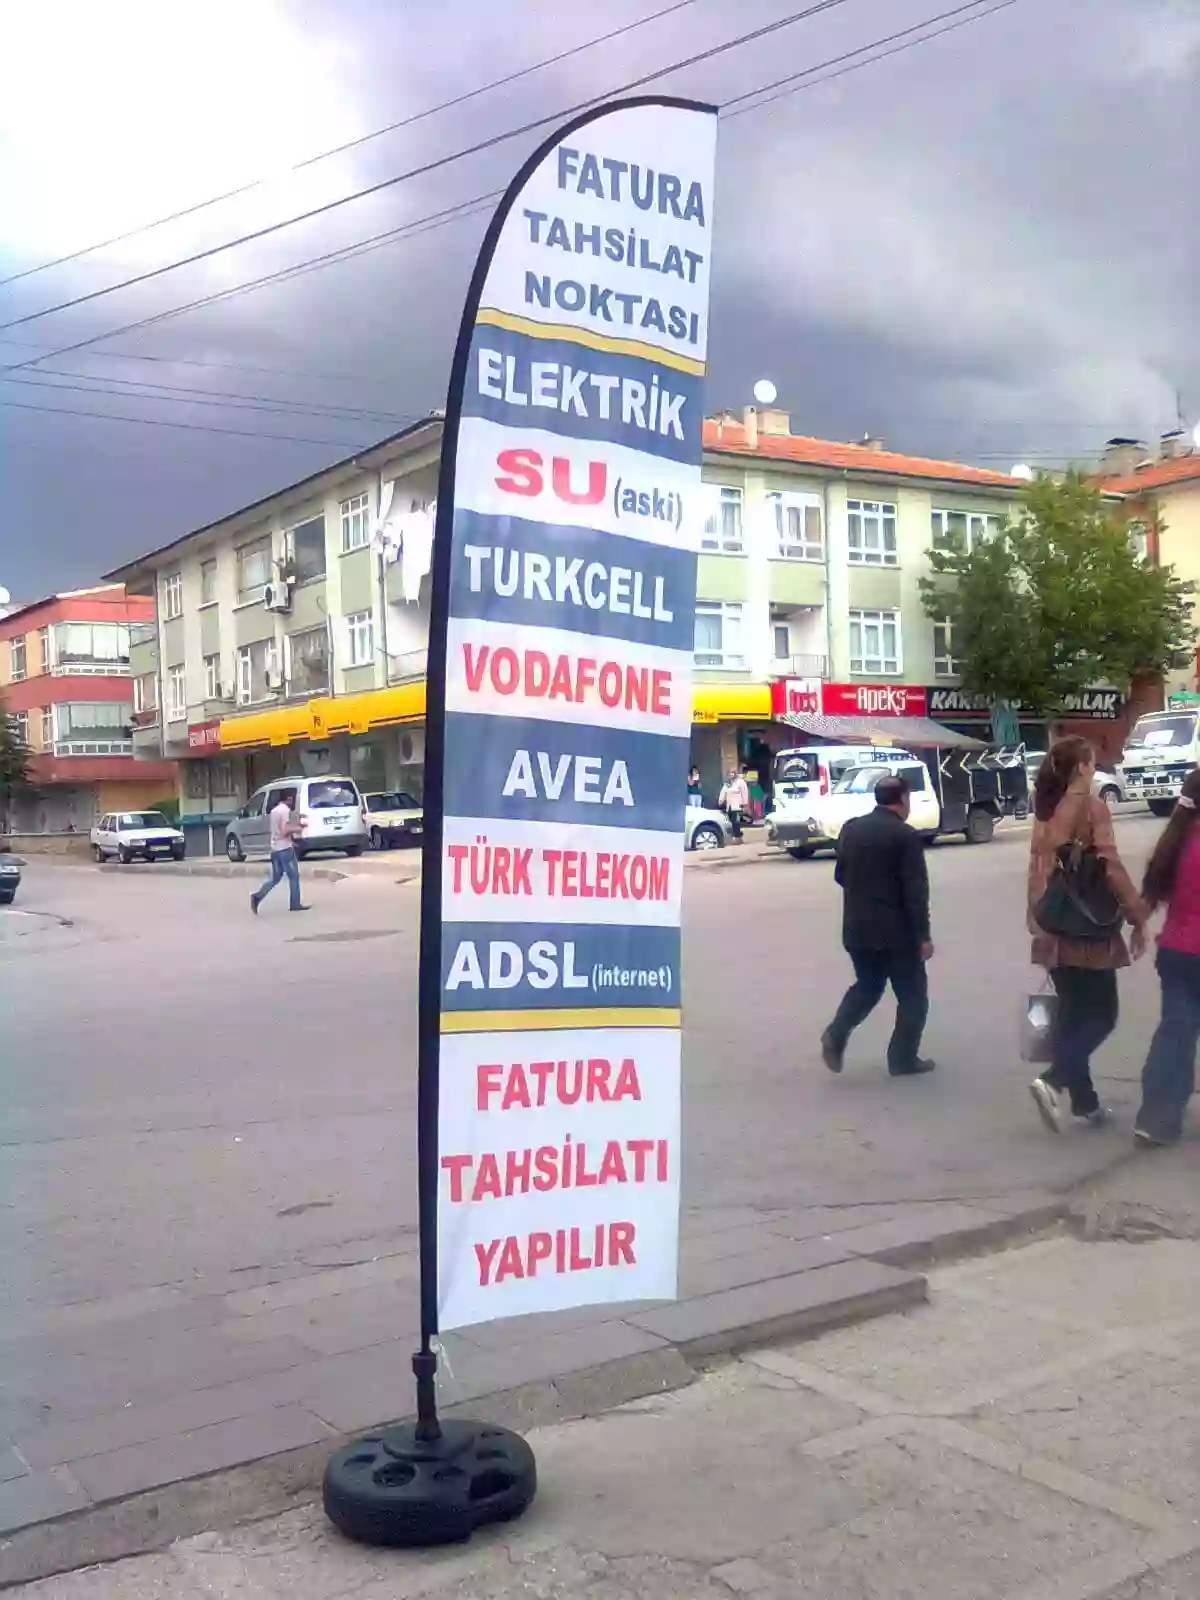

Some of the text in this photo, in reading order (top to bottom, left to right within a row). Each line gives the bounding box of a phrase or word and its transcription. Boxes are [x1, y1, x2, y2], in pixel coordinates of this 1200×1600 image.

[557, 146, 705, 227] FATURA
[523, 208, 703, 284] TAHSİLAT
[525, 270, 700, 345] NOKTASI
[477, 348, 686, 440] ELEKTRİK
[495, 448, 682, 532] SU (aski)
[464, 543, 674, 623] TURKCELL
[463, 643, 672, 716] VODAFONE
[502, 749, 634, 806] AVEA
[447, 836, 671, 901] TÜRK TELEKOM
[445, 940, 673, 993] ADSL (internet)
[476, 1058, 642, 1111] FATURA
[441, 1133, 669, 1203] TAHSİLATI
[473, 1221, 637, 1286] YAPILIR
